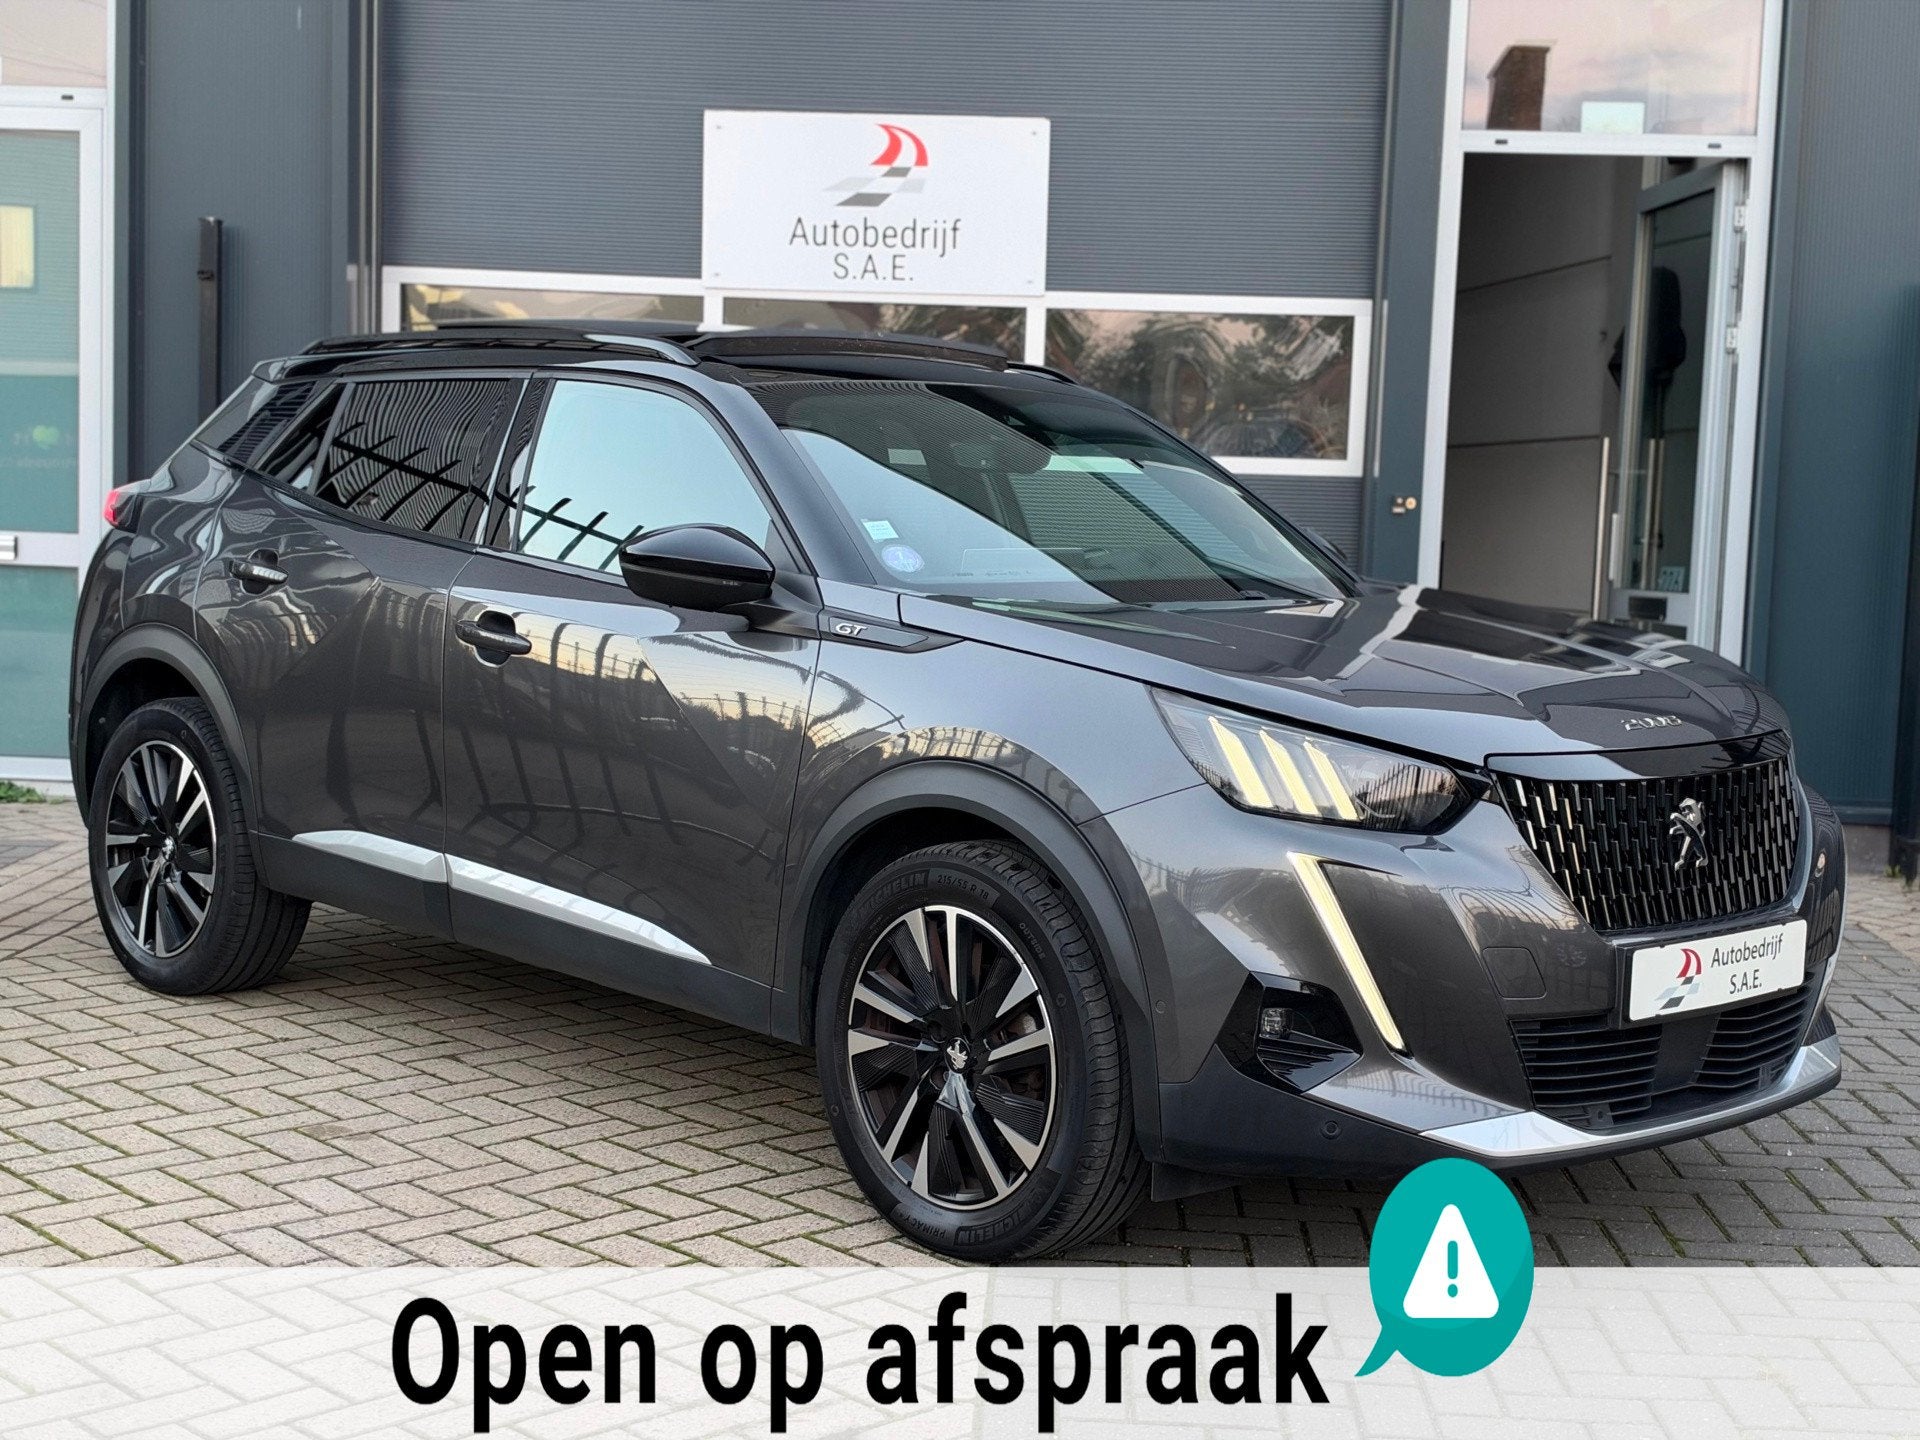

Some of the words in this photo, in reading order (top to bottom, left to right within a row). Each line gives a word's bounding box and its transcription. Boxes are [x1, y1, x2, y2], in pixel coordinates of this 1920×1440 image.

[789, 216, 962, 257] Autobedrijf
[833, 253, 914, 281] S.A.E.
[834, 622, 868, 637] GT
[937, 874, 968, 890] 215/55
[970, 884, 978, 894] R
[979, 888, 989, 900] 18
[1710, 933, 1783, 968] Autobedrijf
[1729, 968, 1763, 995] S.A.E.
[904, 1214, 946, 1239] PRIMACY
